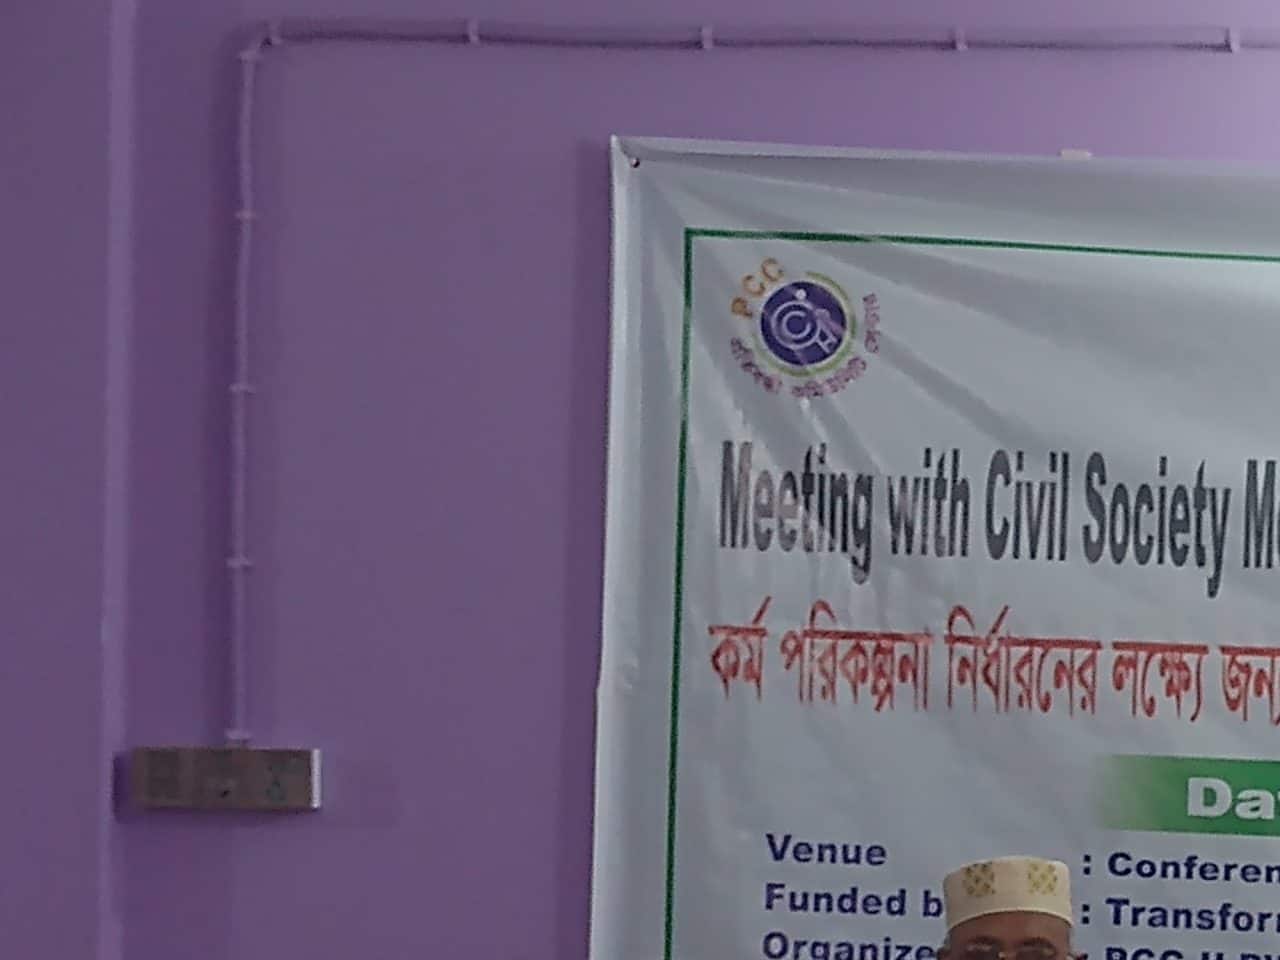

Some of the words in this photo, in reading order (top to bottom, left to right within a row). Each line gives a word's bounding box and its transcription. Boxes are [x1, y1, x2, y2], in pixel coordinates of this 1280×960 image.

[731, 258, 784, 318] PCC
[719, 441, 873, 584] Meeting
[888, 447, 970, 557] with
[985, 449, 1069, 561] Civil
[1082, 452, 1231, 599] Society
[708, 596, 771, 699] কর্ম
[781, 600, 933, 712] পরিকল্পনা
[944, 605, 1100, 718] নির্ধারনের
[1112, 640, 1209, 722] লক্ষ্যে
[766, 833, 887, 866] Venue
[764, 883, 907, 917] Funded
[922, 890, 944, 918] b
